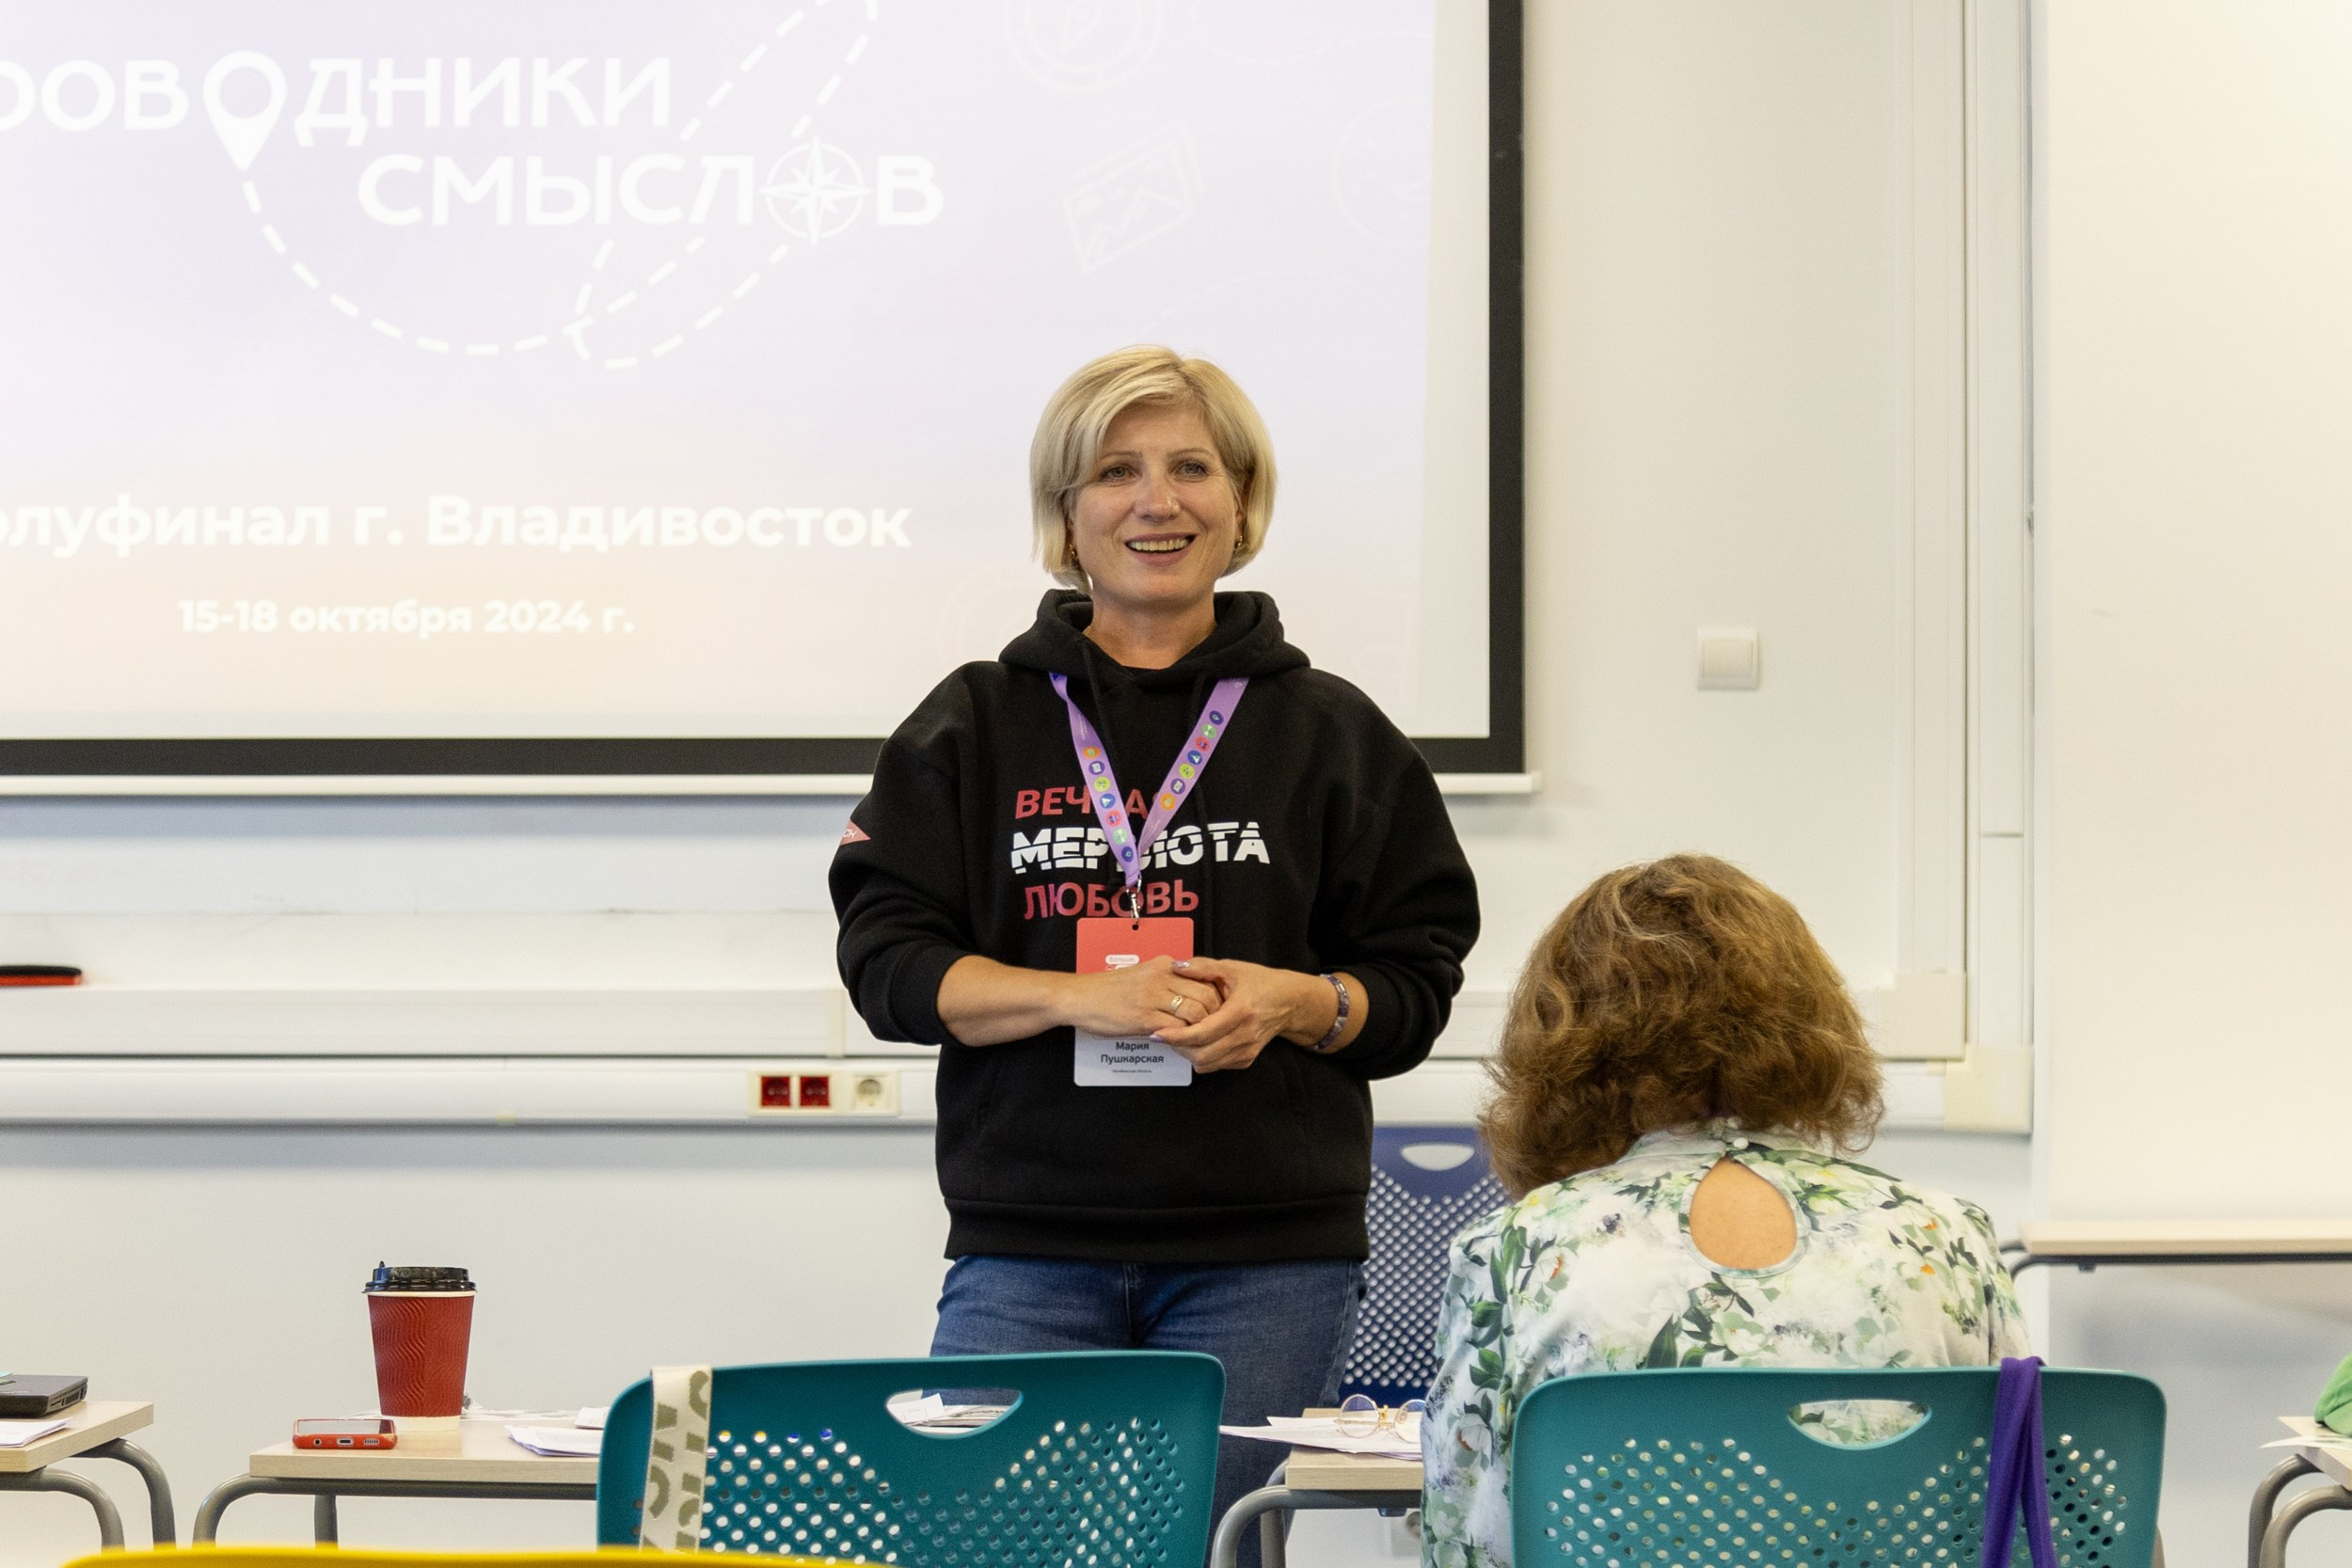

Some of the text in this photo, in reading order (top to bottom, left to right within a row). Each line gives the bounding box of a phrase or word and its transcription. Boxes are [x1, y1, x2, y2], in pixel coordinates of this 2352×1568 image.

[354, 502, 404, 546] г.
[428, 495, 912, 553] Владивосток
[179, 598, 635, 639] 15-18 октября 2024 г.
[1015, 786, 1162, 819] ВЕЧА
[1011, 821, 1270, 874] МЕРЛОТА
[1024, 879, 1200, 920] ЛЮБОВЬ
[1101, 1053, 1164, 1065] Пушкарская
[1116, 1041, 1150, 1052] Мария
